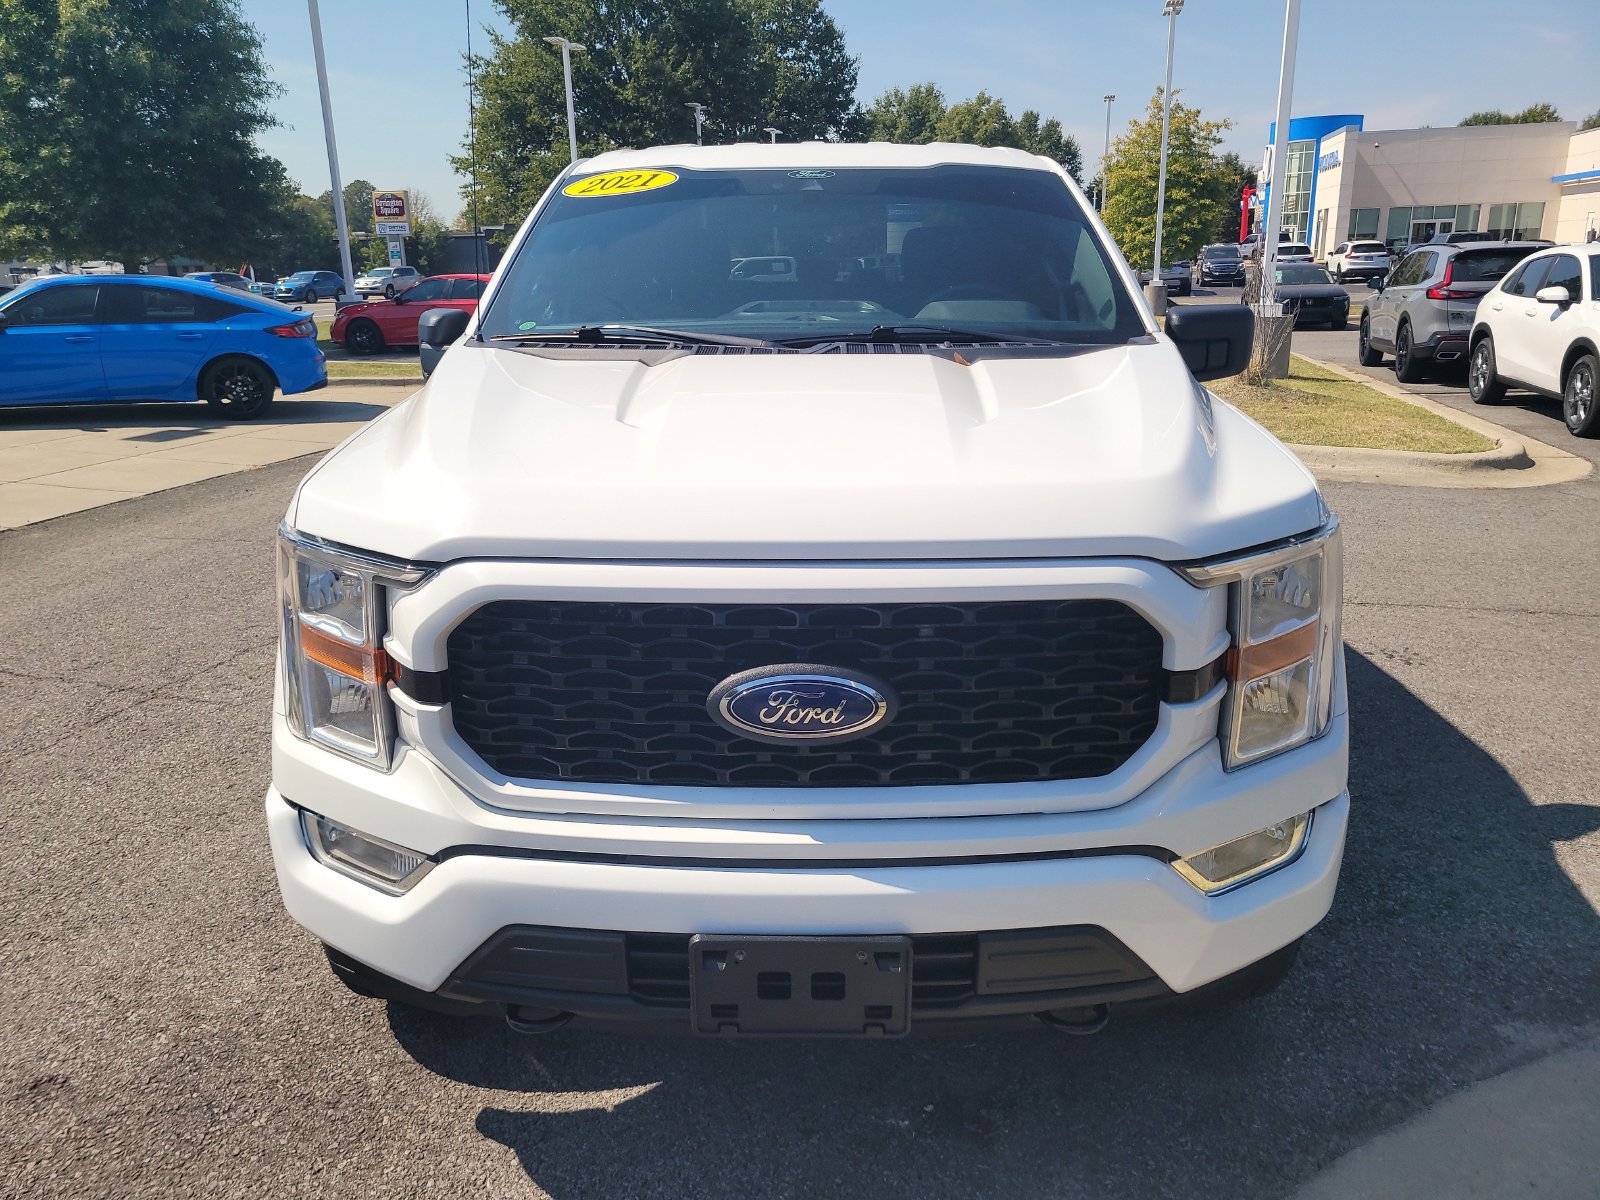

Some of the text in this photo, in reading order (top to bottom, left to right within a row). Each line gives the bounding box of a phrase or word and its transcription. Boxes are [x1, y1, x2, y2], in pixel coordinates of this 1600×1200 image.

[578, 173, 661, 194] 2021
[380, 207, 399, 216] Square
[759, 689, 847, 724] Ford
